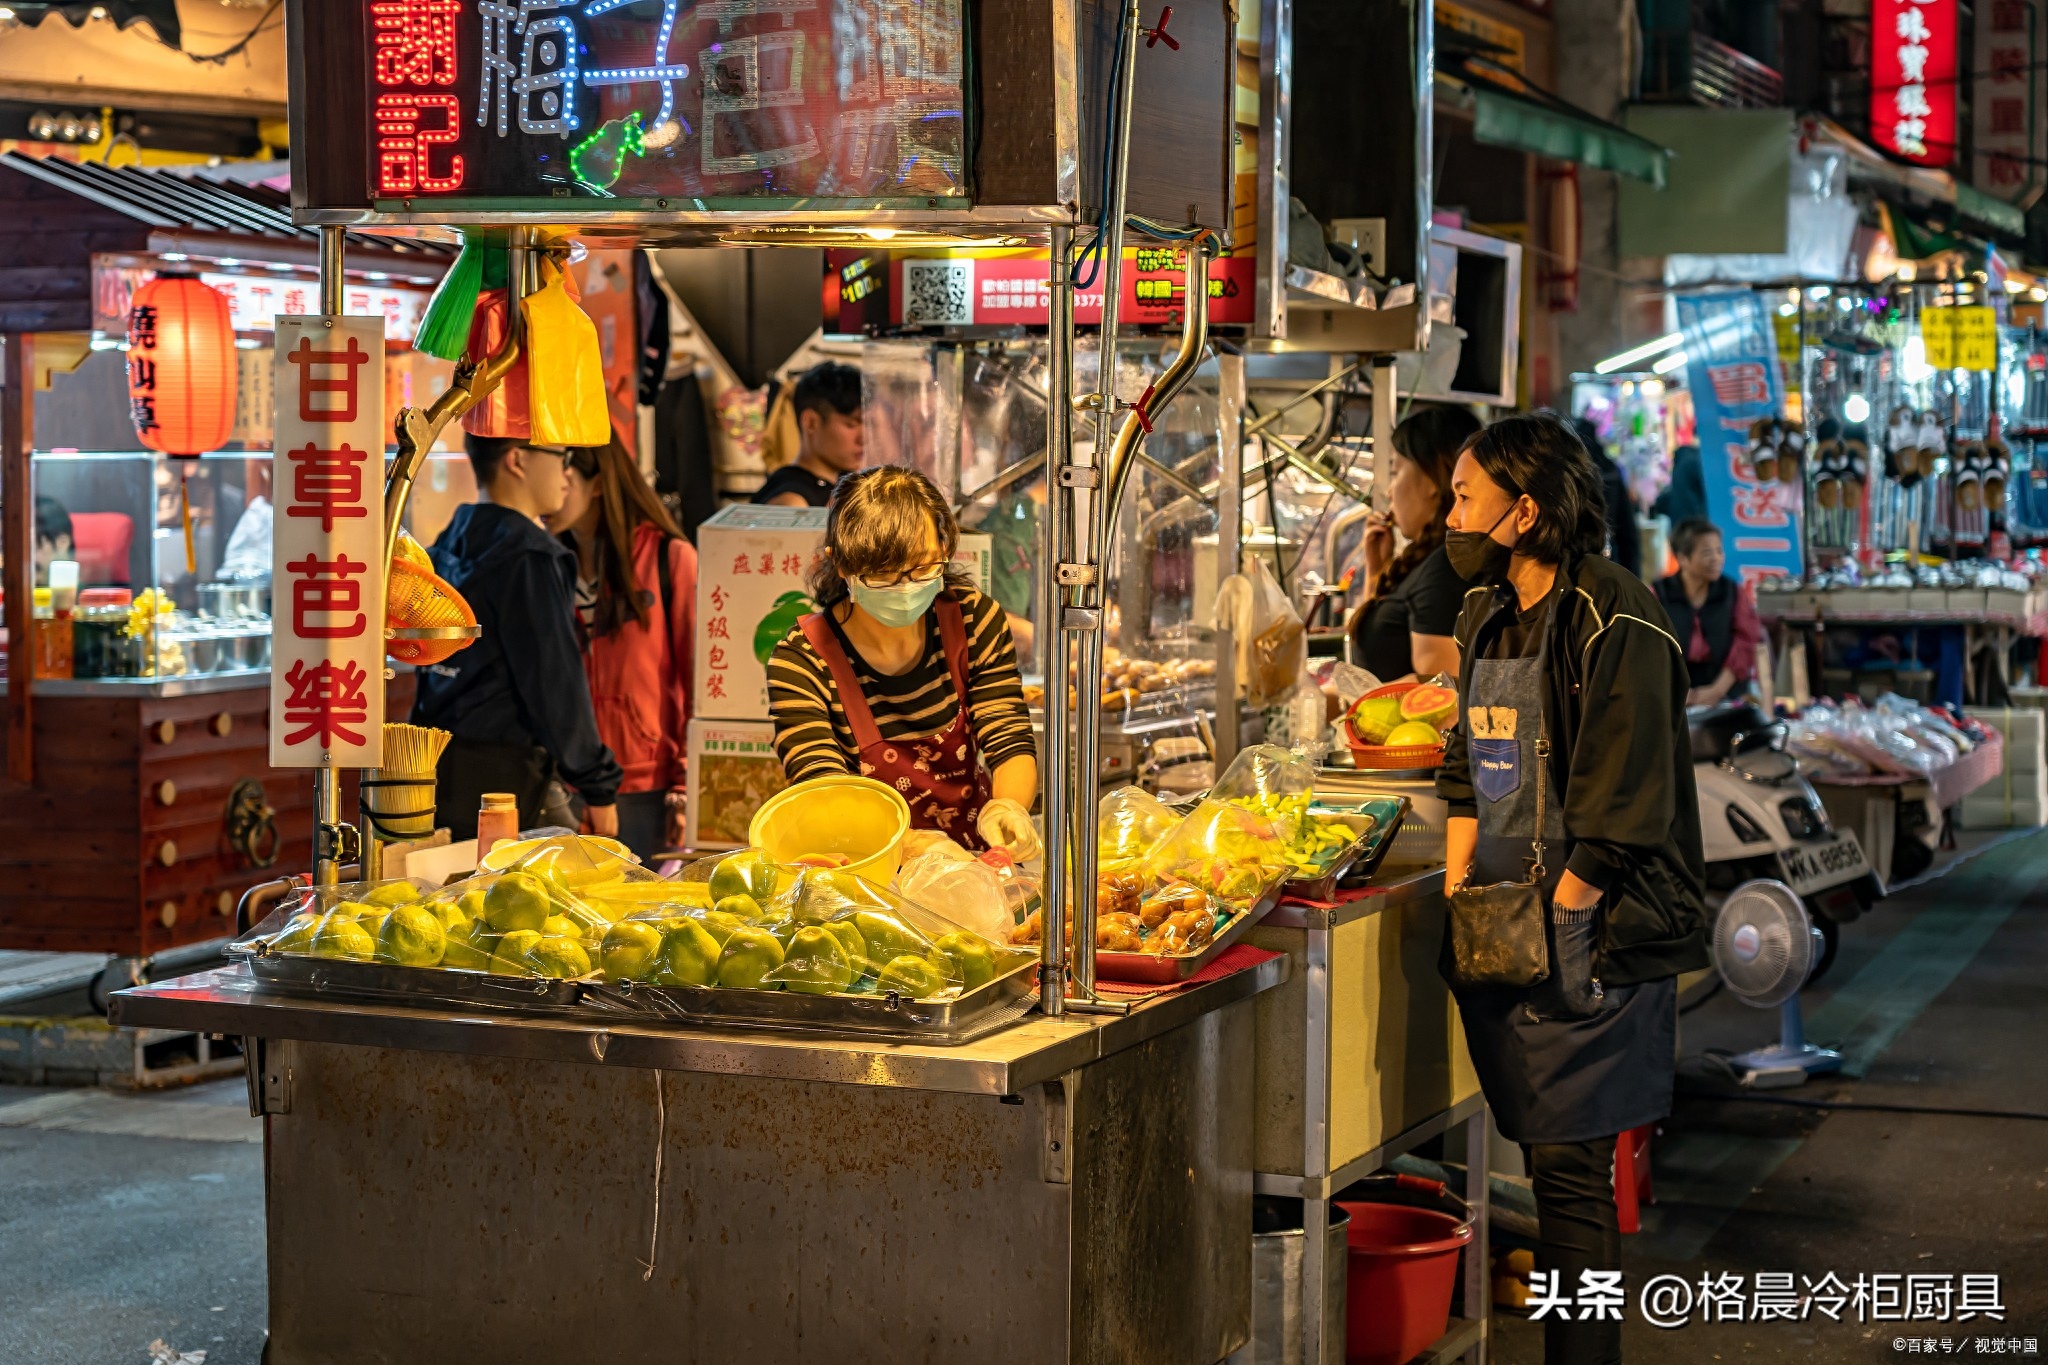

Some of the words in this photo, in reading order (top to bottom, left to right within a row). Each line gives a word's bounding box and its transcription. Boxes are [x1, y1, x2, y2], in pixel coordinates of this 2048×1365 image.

[371, 0, 464, 190] 謝記
[285, 336, 369, 750] 甘草芭樂
[1481, 759, 1499, 771] Happy
[1500, 760, 1514, 770] Bear
